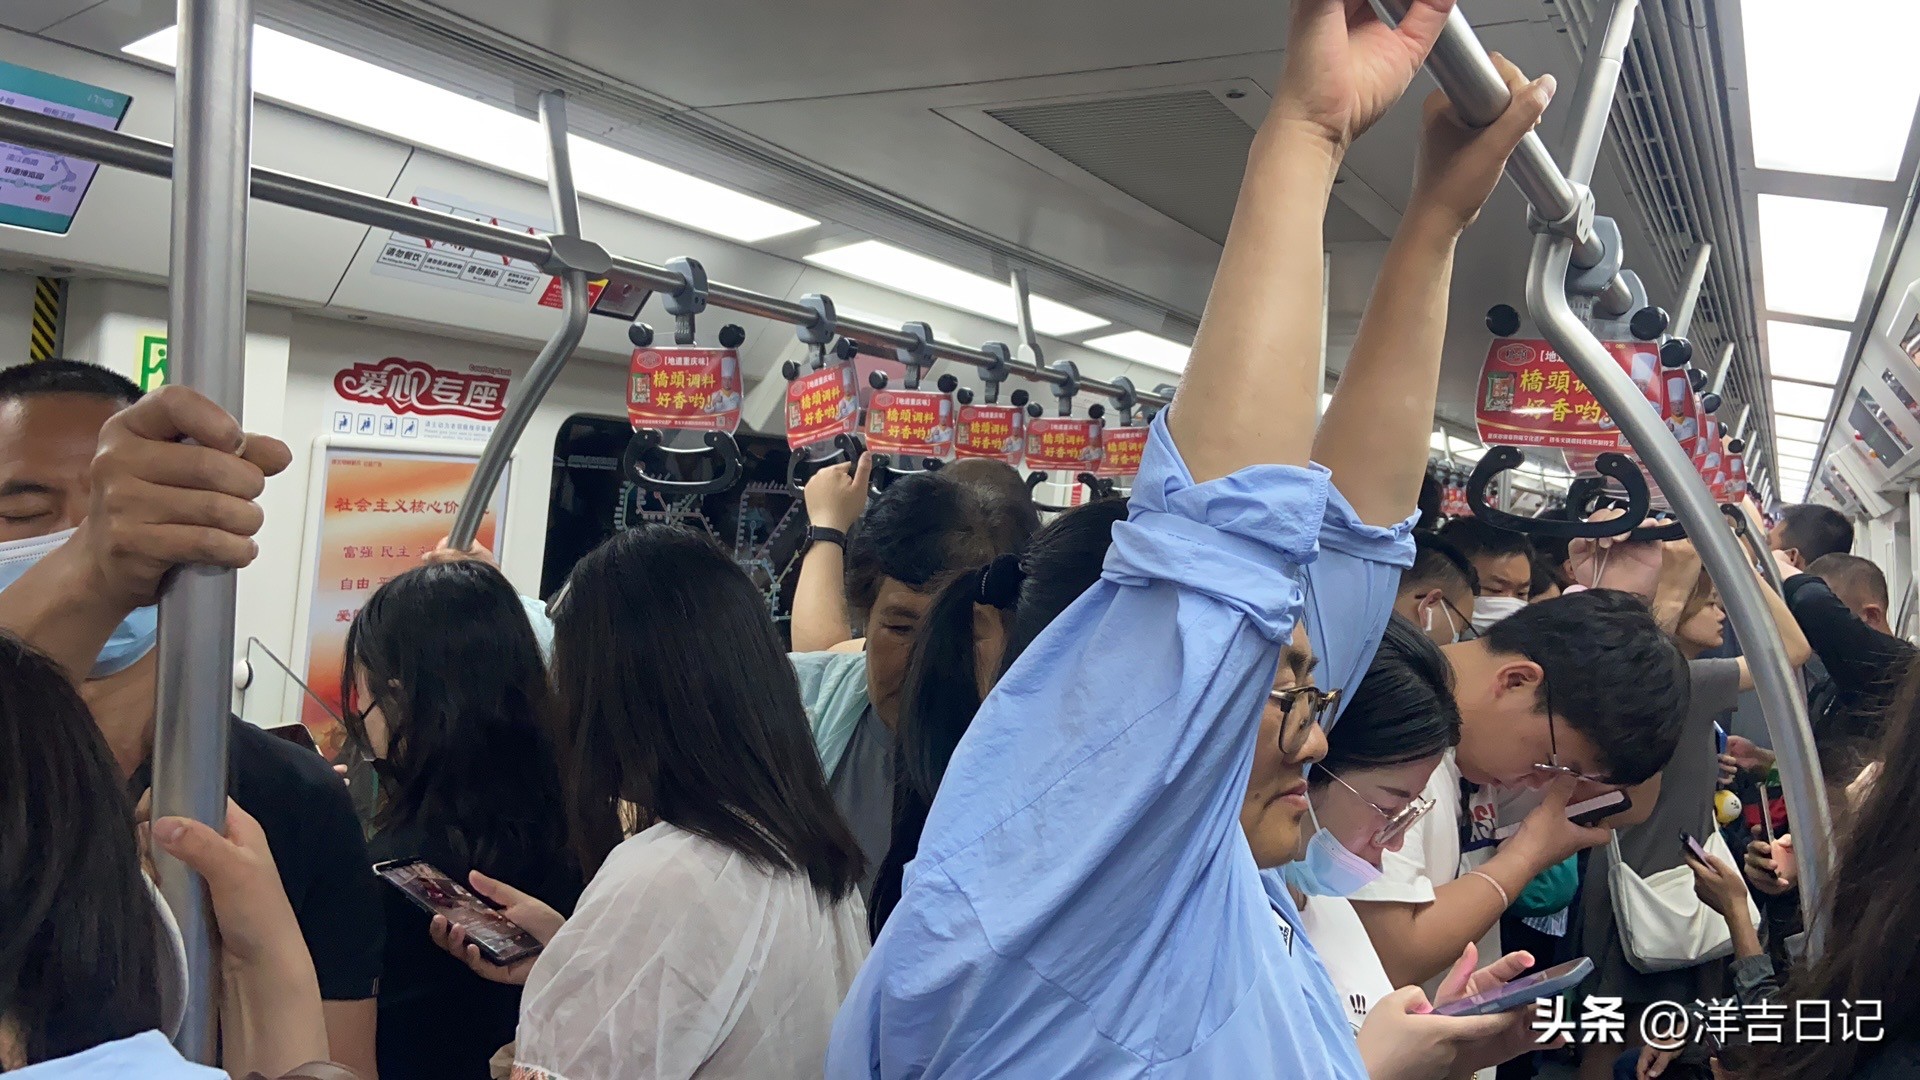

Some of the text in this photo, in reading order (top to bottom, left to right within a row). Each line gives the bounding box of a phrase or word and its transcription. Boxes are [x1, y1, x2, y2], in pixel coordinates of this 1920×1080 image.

[343, 364, 501, 411] 爱心专座
[1520, 368, 1592, 395] 橋頭
[334, 498, 490, 515] 社会主义核心价
[343, 545, 374, 559] 富强
[381, 545, 411, 558] 民主
[340, 577, 370, 591] 自由
